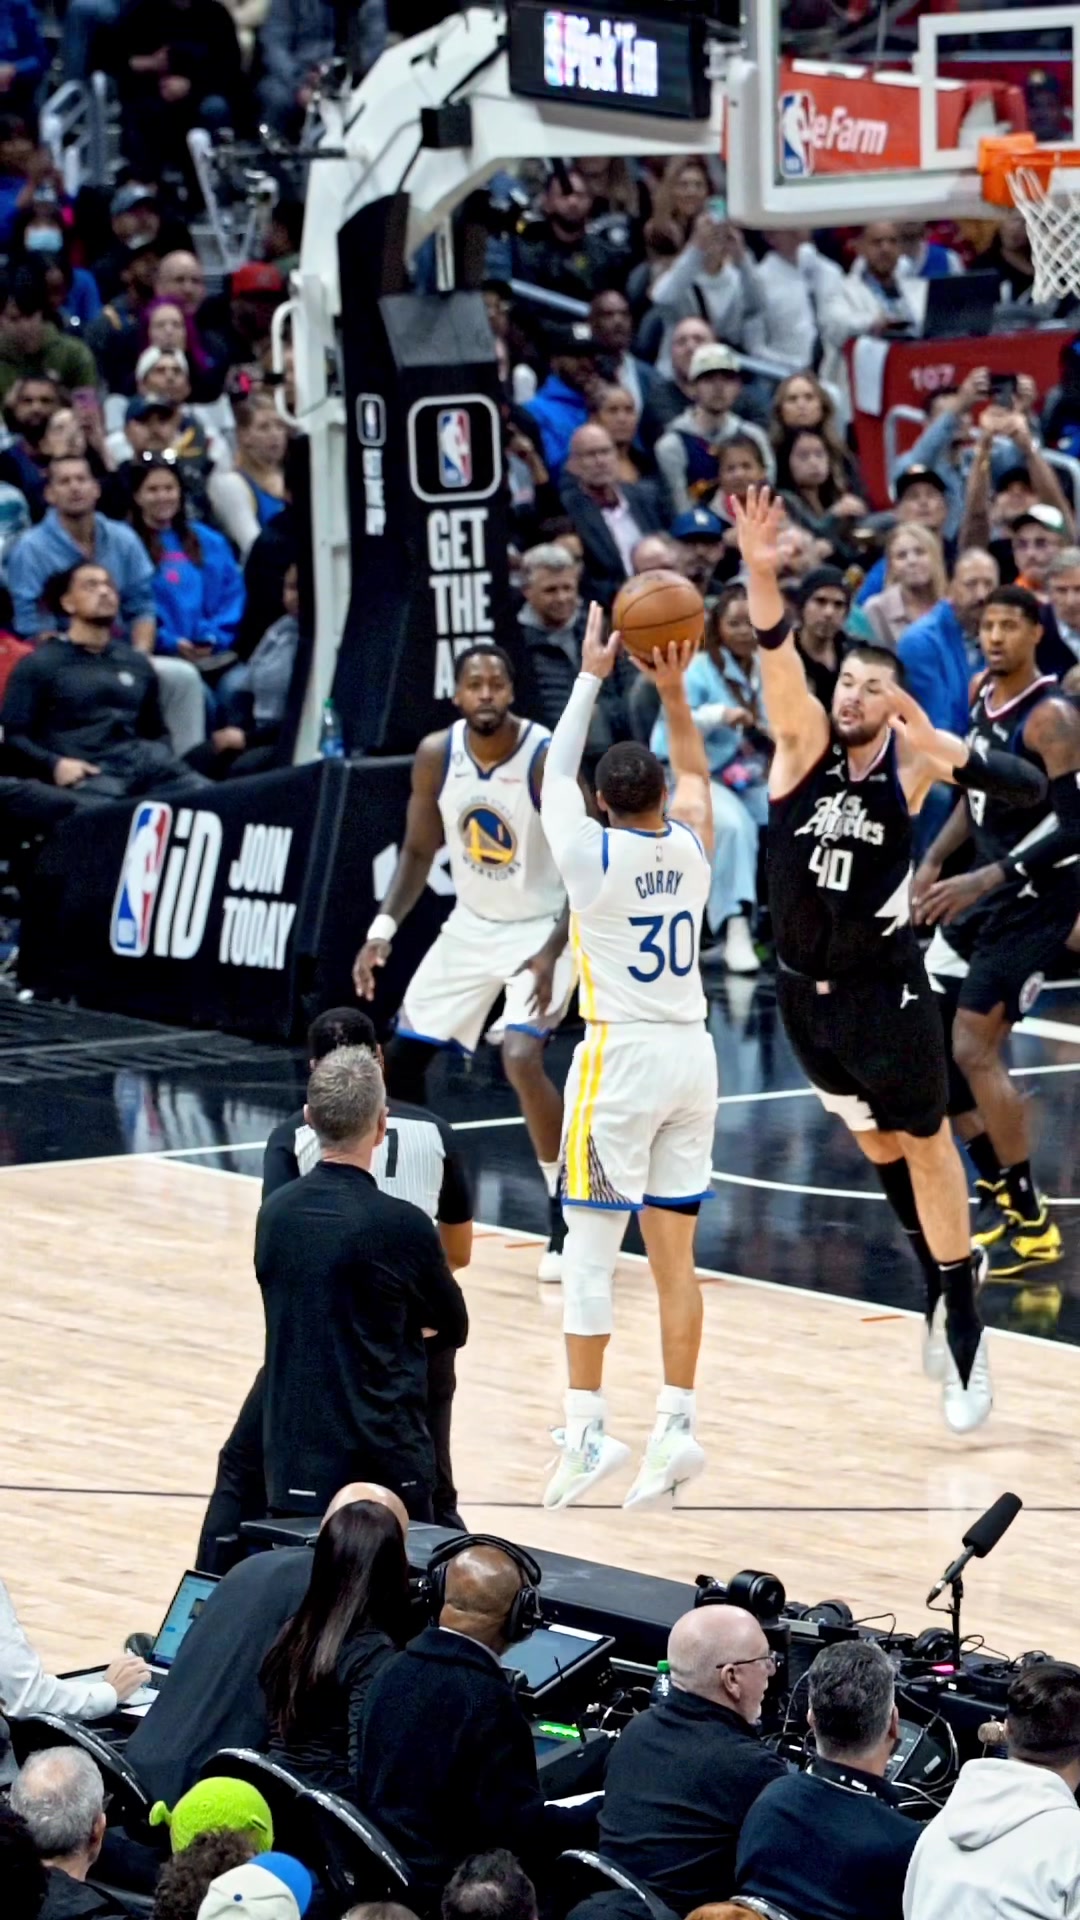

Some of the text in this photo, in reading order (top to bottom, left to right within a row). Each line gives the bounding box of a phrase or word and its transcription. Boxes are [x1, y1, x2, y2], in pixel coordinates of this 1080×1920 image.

[427, 507, 488, 572] GET
[429, 571, 495, 635] THE
[228, 823, 293, 894] JOIN
[634, 869, 684, 899] CURRY
[808, 845, 854, 892] 40
[219, 896, 297, 971] TODAY
[627, 910, 695, 983] 30
